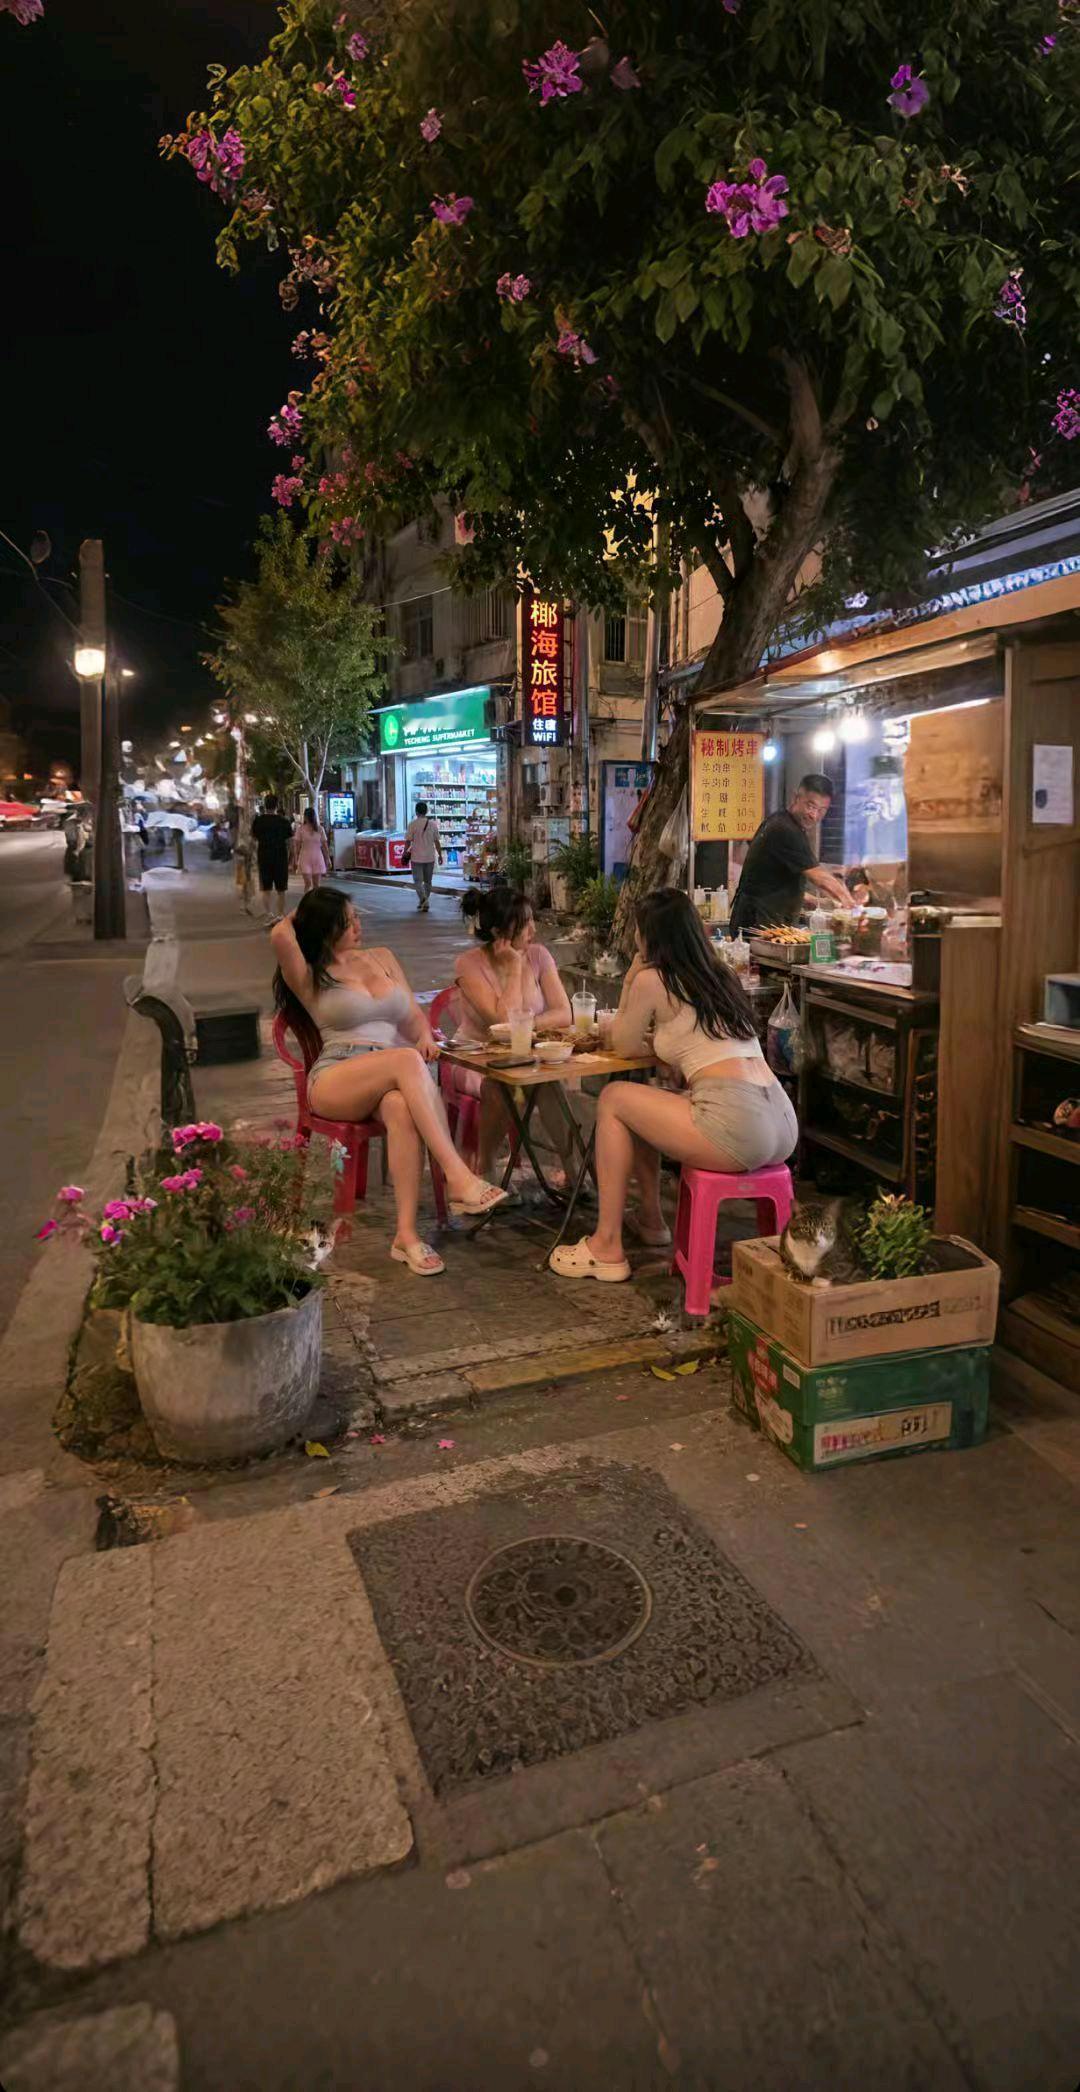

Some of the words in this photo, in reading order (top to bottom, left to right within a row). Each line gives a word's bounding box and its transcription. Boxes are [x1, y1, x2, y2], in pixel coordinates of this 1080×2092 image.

[530, 600, 558, 716] 椰海旅馆
[432, 729, 475, 741] SUPERMARKET
[701, 738, 758, 757] 秘制烤串
